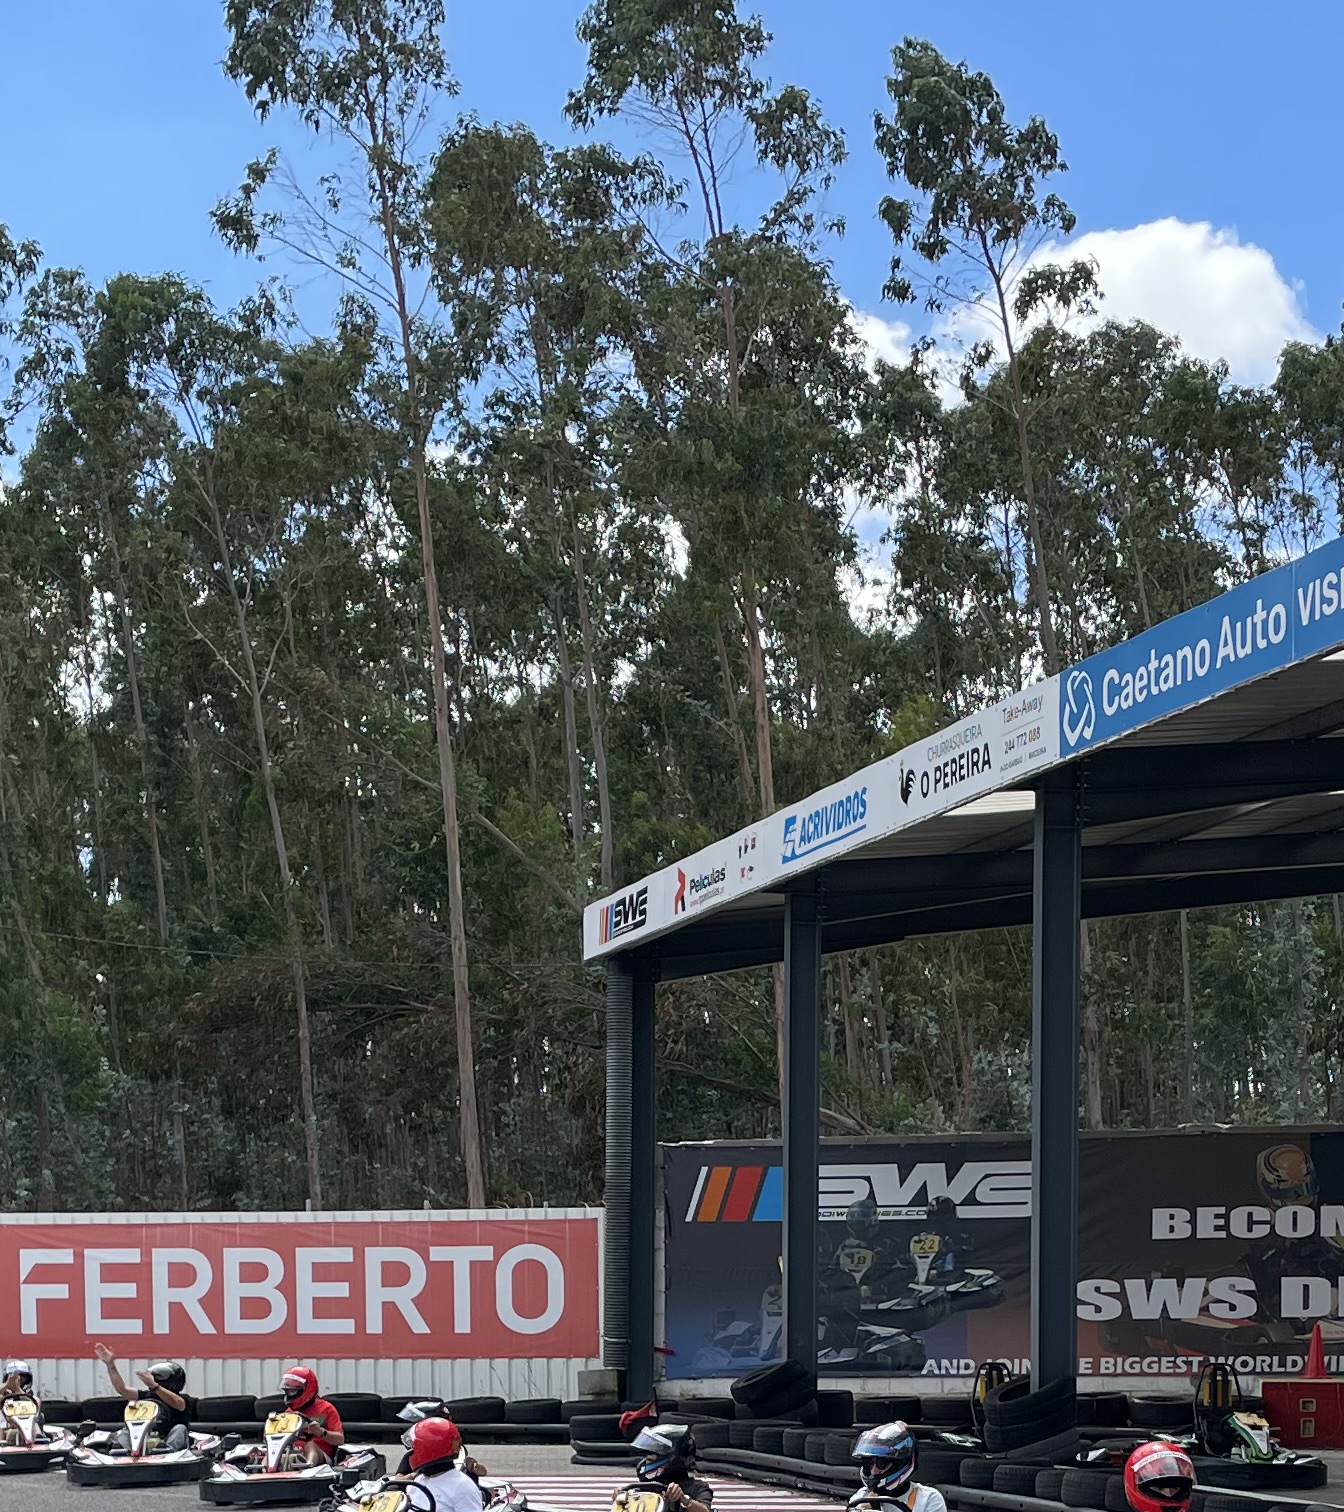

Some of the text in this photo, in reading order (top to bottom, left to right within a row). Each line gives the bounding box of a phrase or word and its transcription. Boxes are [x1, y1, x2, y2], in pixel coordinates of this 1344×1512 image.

[1102, 637, 1210, 716] Caetano
[1216, 601, 1286, 670] Auto
[1002, 695, 1043, 725] Take-Away
[921, 771, 930, 798] O
[934, 742, 992, 793] PEREIRA
[798, 787, 867, 848] ACRIVIDROS
[19, 1243, 565, 1335] FERBERTO
[1076, 1277, 1257, 1321] SWS
[921, 1359, 976, 1375] AND
[1099, 1356, 1203, 1374] BIGGEST
